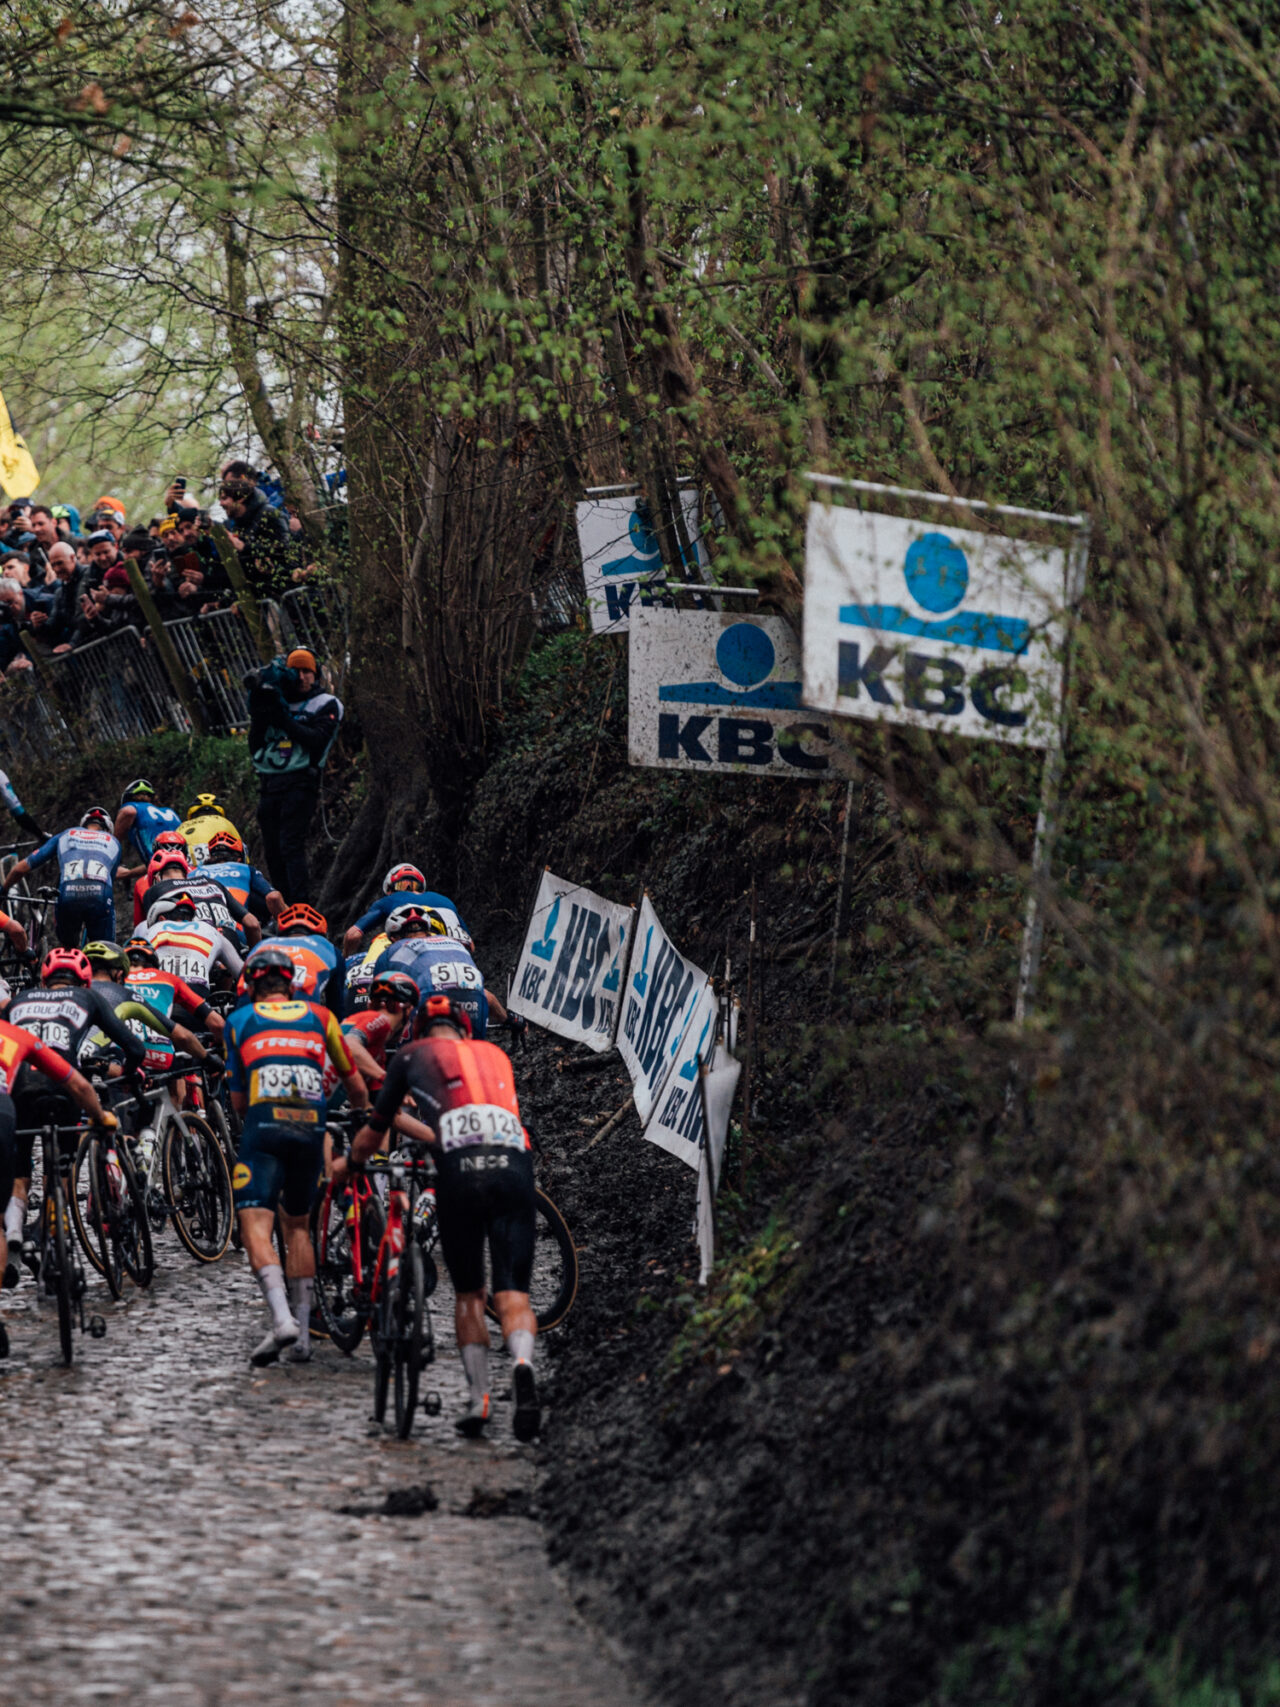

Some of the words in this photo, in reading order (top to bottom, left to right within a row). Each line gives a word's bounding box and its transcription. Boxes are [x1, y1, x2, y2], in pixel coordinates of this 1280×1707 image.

[837, 640, 1029, 727] KBC
[658, 712, 830, 770] KBC
[70, 862, 79, 875] 7
[96, 862, 105, 875] 7
[182, 959, 206, 978] 141
[437, 965, 450, 982] 5
[463, 966, 476, 982] 5
[542, 903, 611, 1031] KBC
[518, 962, 547, 1005] KBC
[27, 990, 74, 1000] easypost
[26, 1003, 80, 1021] EDUCATION
[42, 1024, 70, 1046] 103
[252, 1036, 324, 1054] TREK
[260, 1068, 292, 1088] 135
[658, 1085, 688, 1131] KBC
[446, 1111, 481, 1136] 126
[460, 1154, 509, 1172] INEOS
